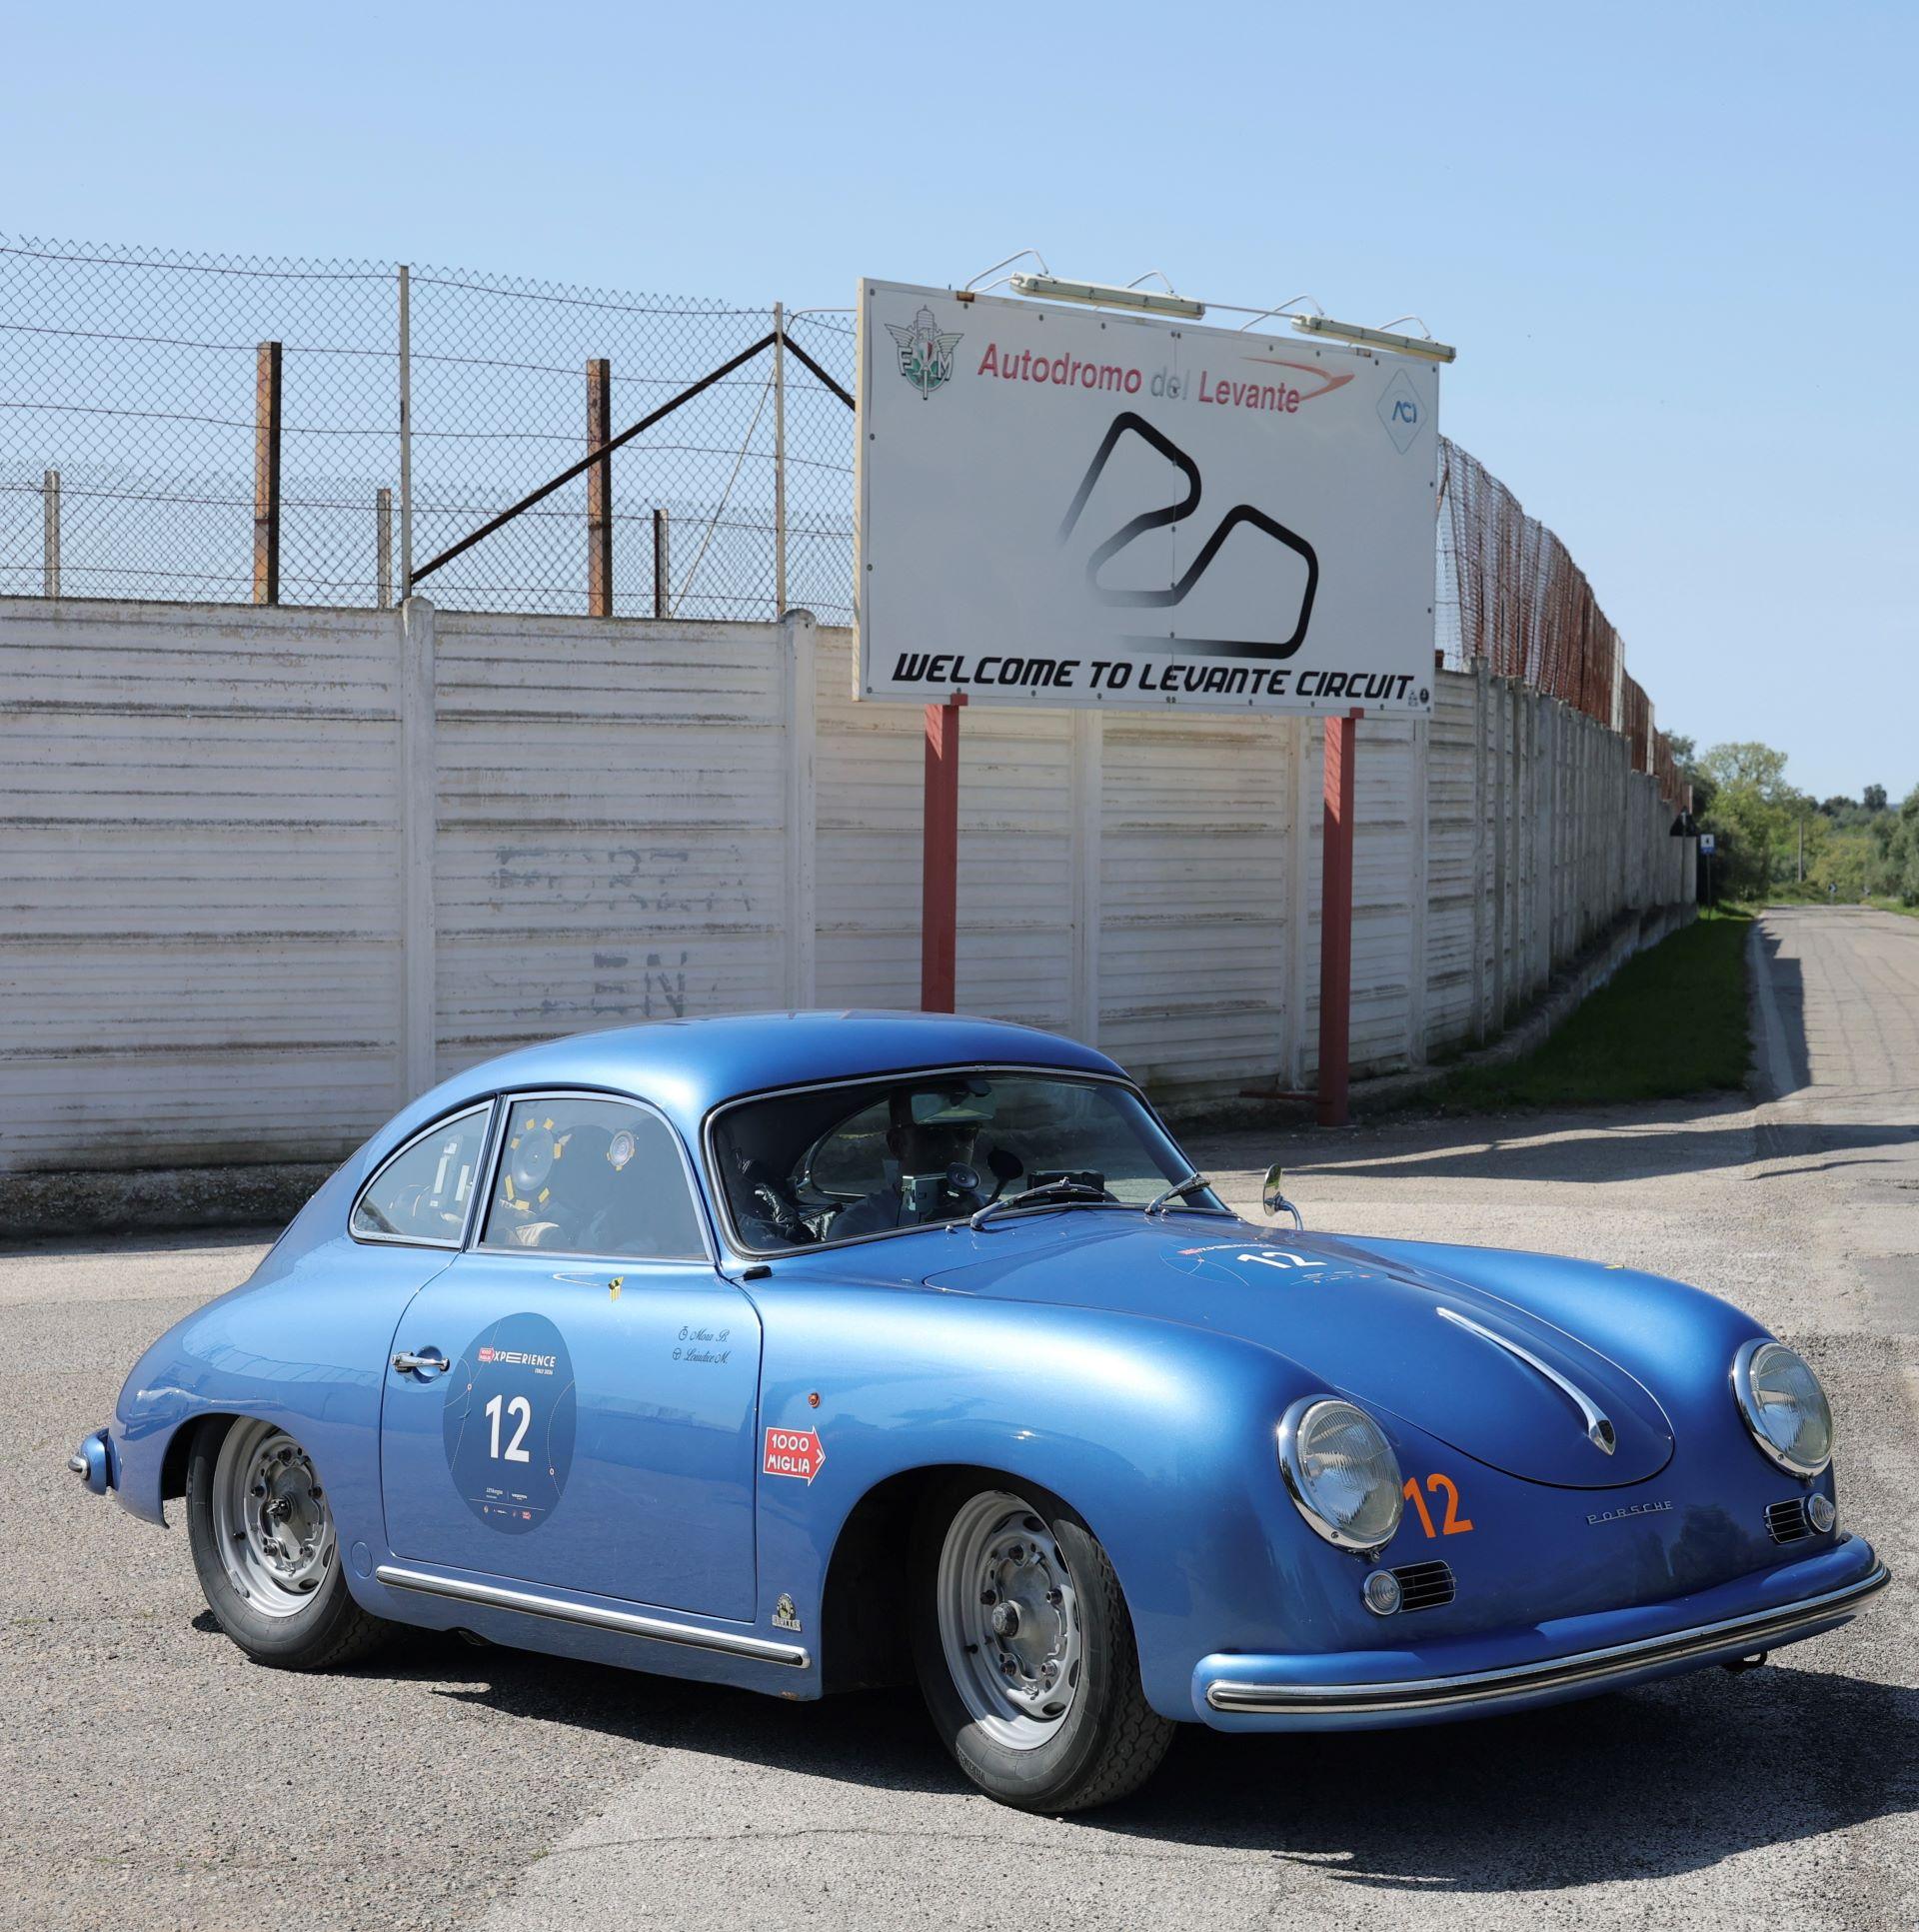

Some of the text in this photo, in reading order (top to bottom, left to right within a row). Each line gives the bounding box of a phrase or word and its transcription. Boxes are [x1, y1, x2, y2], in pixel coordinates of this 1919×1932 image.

[977, 343, 1301, 413] Autodromo del Levante
[1391, 401, 1417, 424] ACI
[892, 653, 1080, 688] WELCOME
[1089, 662, 1133, 689] TO
[1137, 664, 1292, 695] LEVANTE
[1295, 671, 1415, 700] CIRCUIT
[1236, 1251, 1328, 1268] 12
[493, 1350, 557, 1367] XPERIENCE
[485, 1394, 531, 1463] 12
[772, 1433, 810, 1452] 1000
[767, 1453, 811, 1474] MIGLIA
[1403, 1473, 1474, 1538] 12
[1585, 1500, 1674, 1525] PORSCHE
